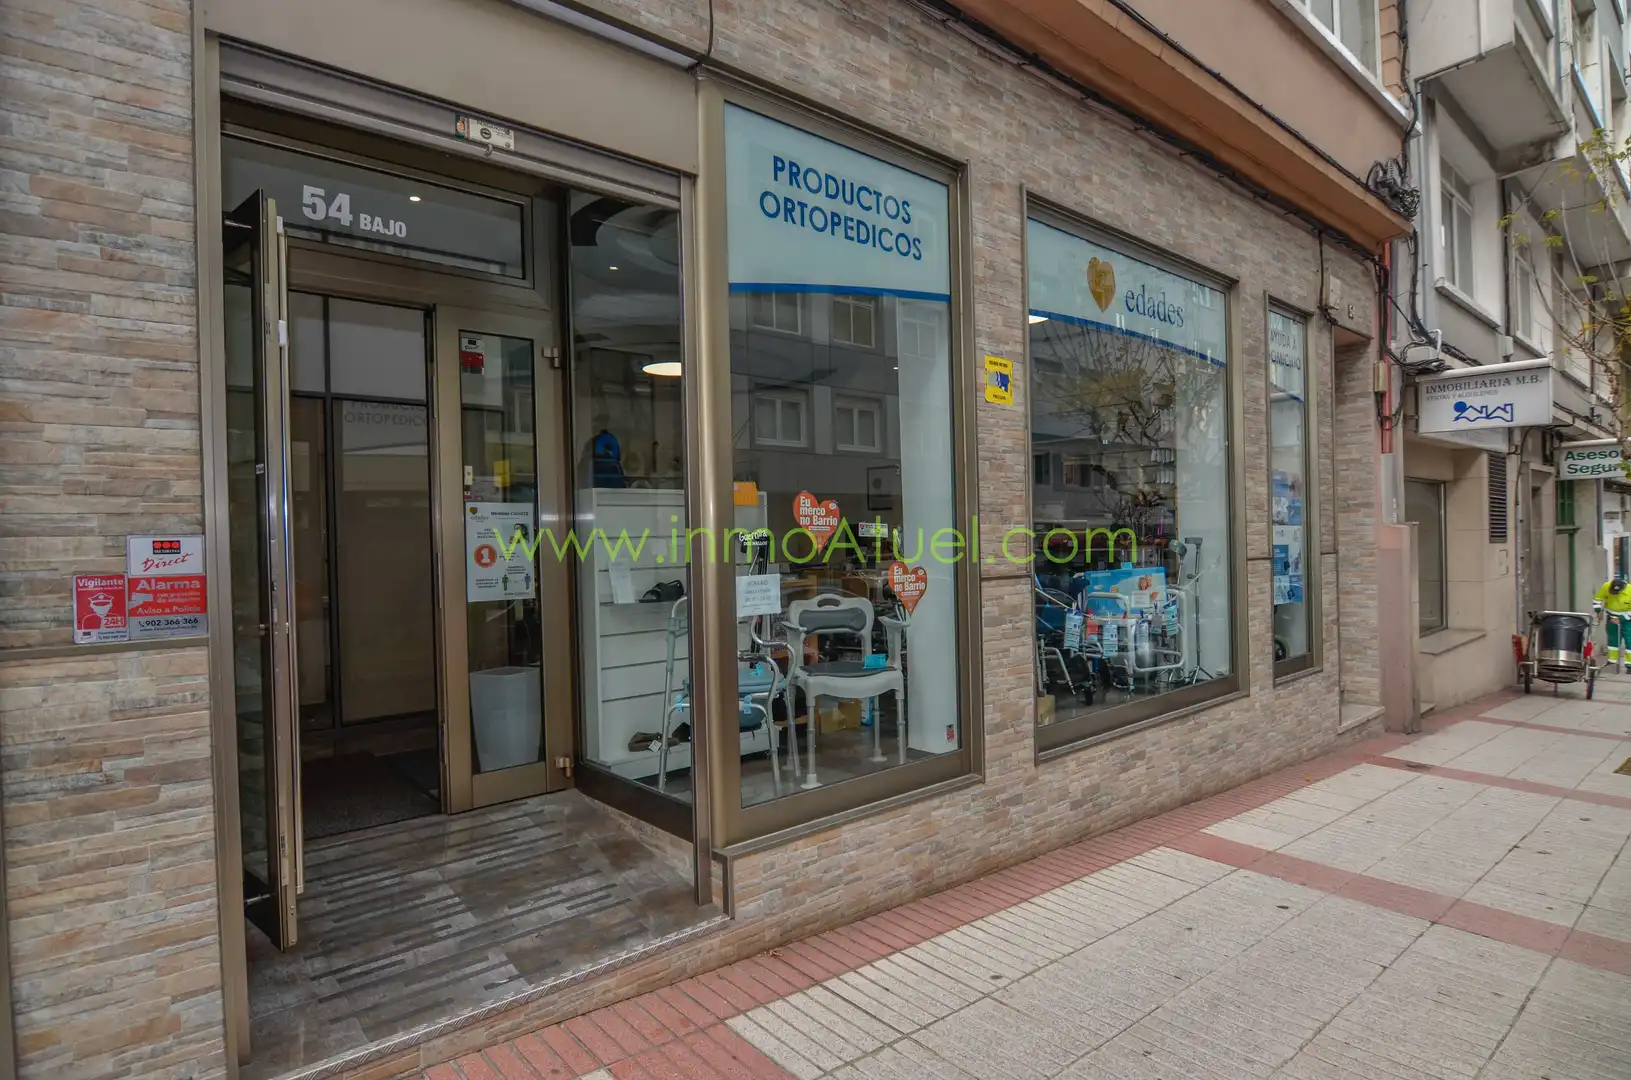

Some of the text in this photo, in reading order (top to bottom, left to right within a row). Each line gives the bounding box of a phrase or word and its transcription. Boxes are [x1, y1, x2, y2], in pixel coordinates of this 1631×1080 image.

[773, 154, 912, 225] PRODUCTOS
[302, 184, 407, 238] 54 BAJO
[759, 190, 923, 261] ORTOPEDICOS
[1125, 284, 1185, 328] edades
[1426, 377, 1512, 394] INMOBILIARIA
[800, 495, 811, 507] Eu
[799, 506, 826, 516] merco
[799, 515, 838, 526] no Barrio
[142, 553, 195, 572] Direct
[893, 565, 903, 575] Eu
[77, 578, 124, 589] Vigilante
[135, 578, 201, 591] Alarma
[893, 574, 916, 584] merco
[893, 580, 926, 592] no Barrio
[137, 607, 162, 615] Aviso
[144, 617, 199, 627] 902 366 366
